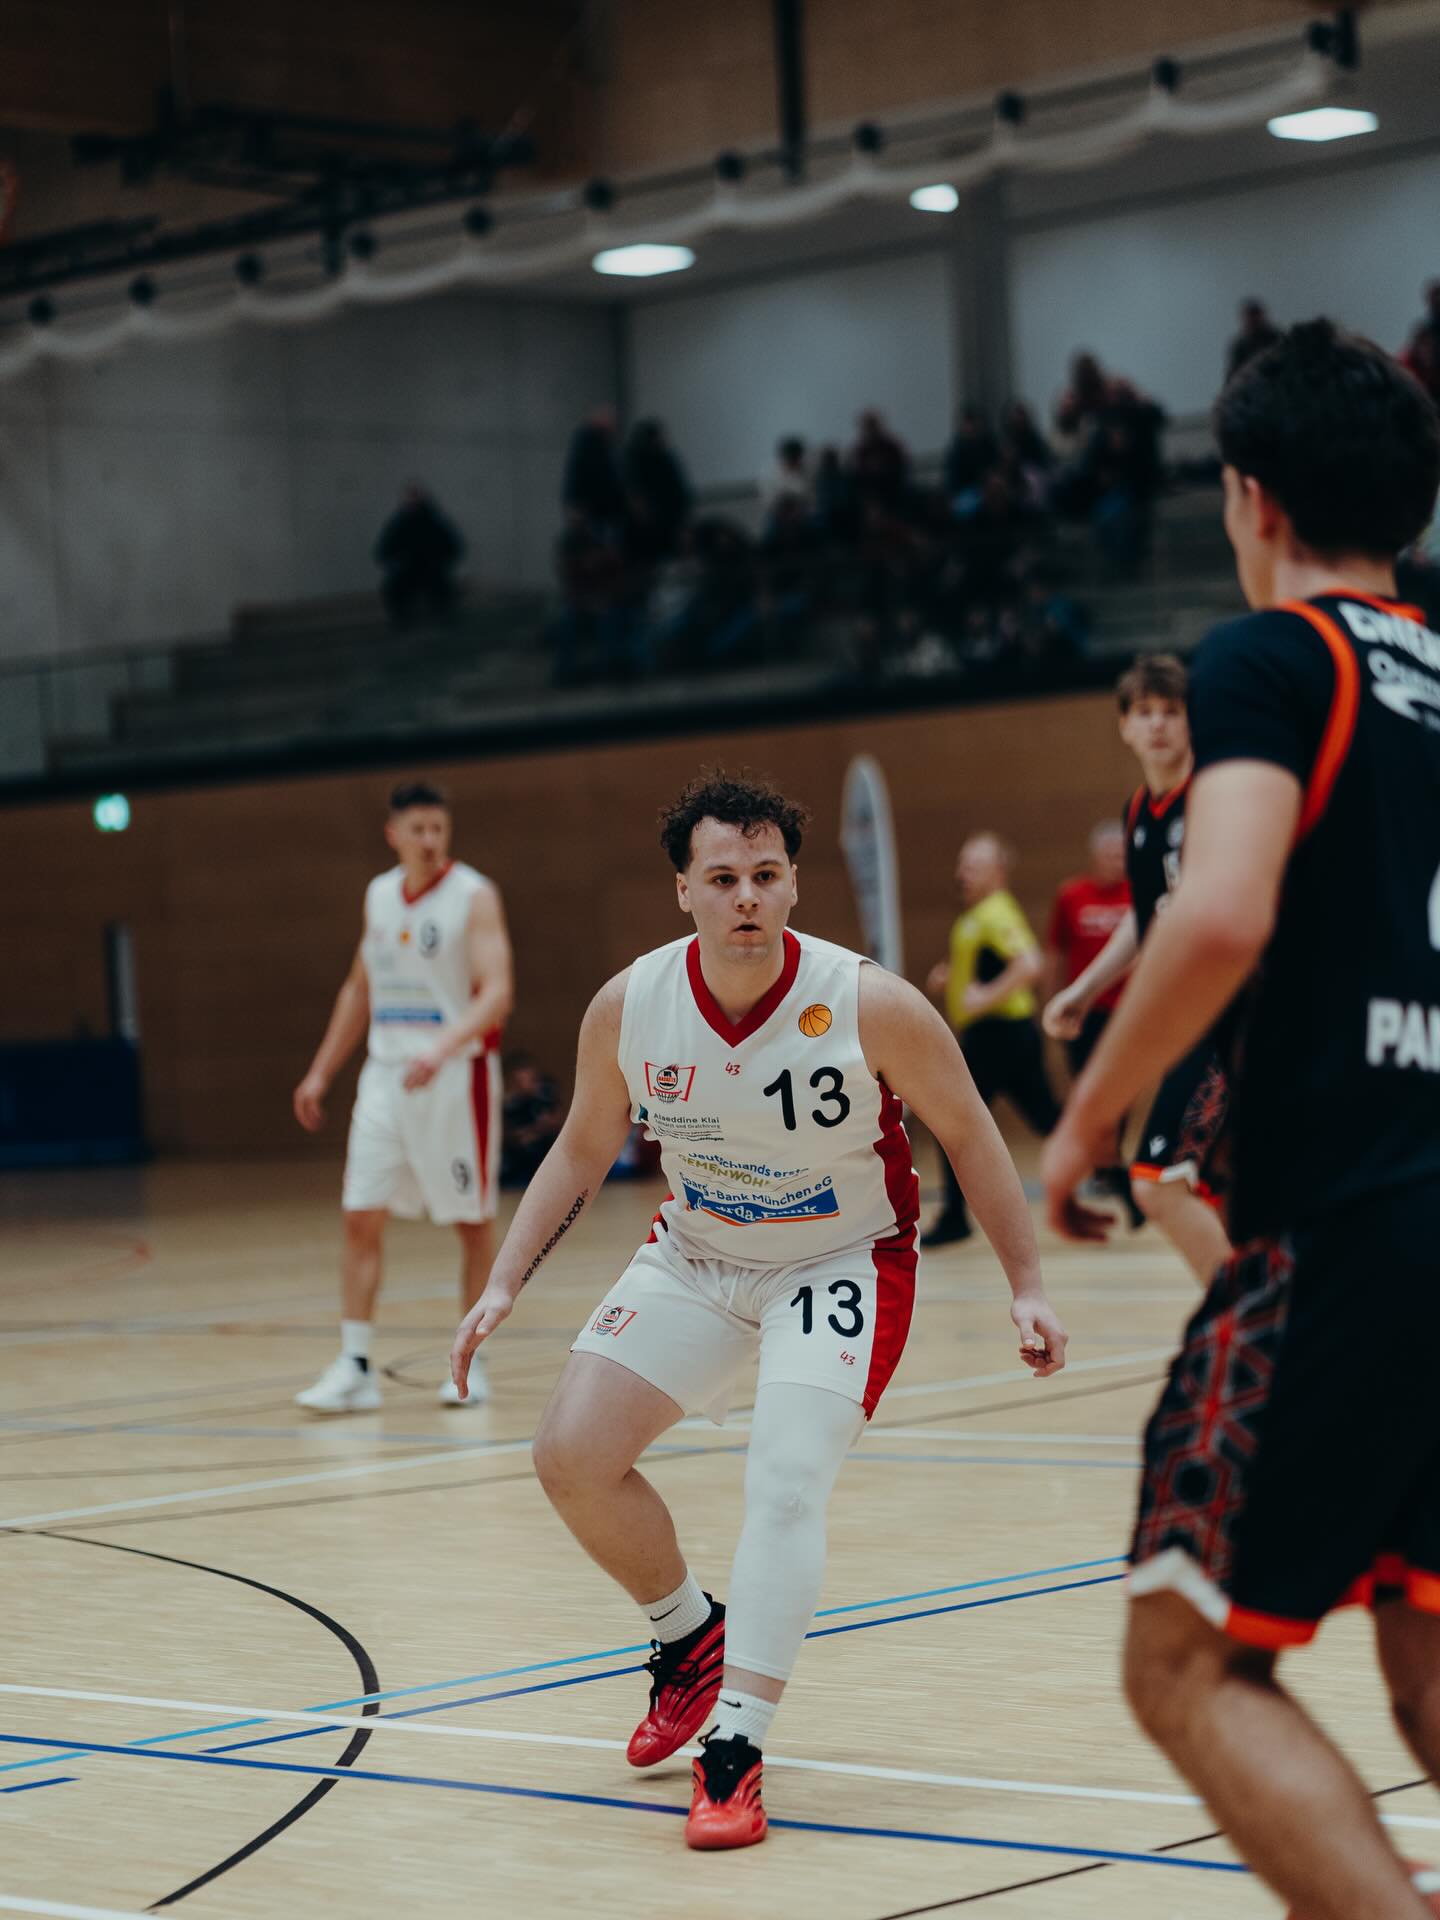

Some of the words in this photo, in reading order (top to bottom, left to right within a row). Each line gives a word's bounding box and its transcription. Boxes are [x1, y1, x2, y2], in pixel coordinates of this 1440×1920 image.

[725, 1062, 741, 1076] 43
[763, 1066, 850, 1131] 13
[774, 1167, 809, 1179] erst
[752, 1186, 812, 1206] München
[815, 1176, 832, 1191] eG
[790, 1280, 864, 1338] 13
[840, 1351, 856, 1366] 43
